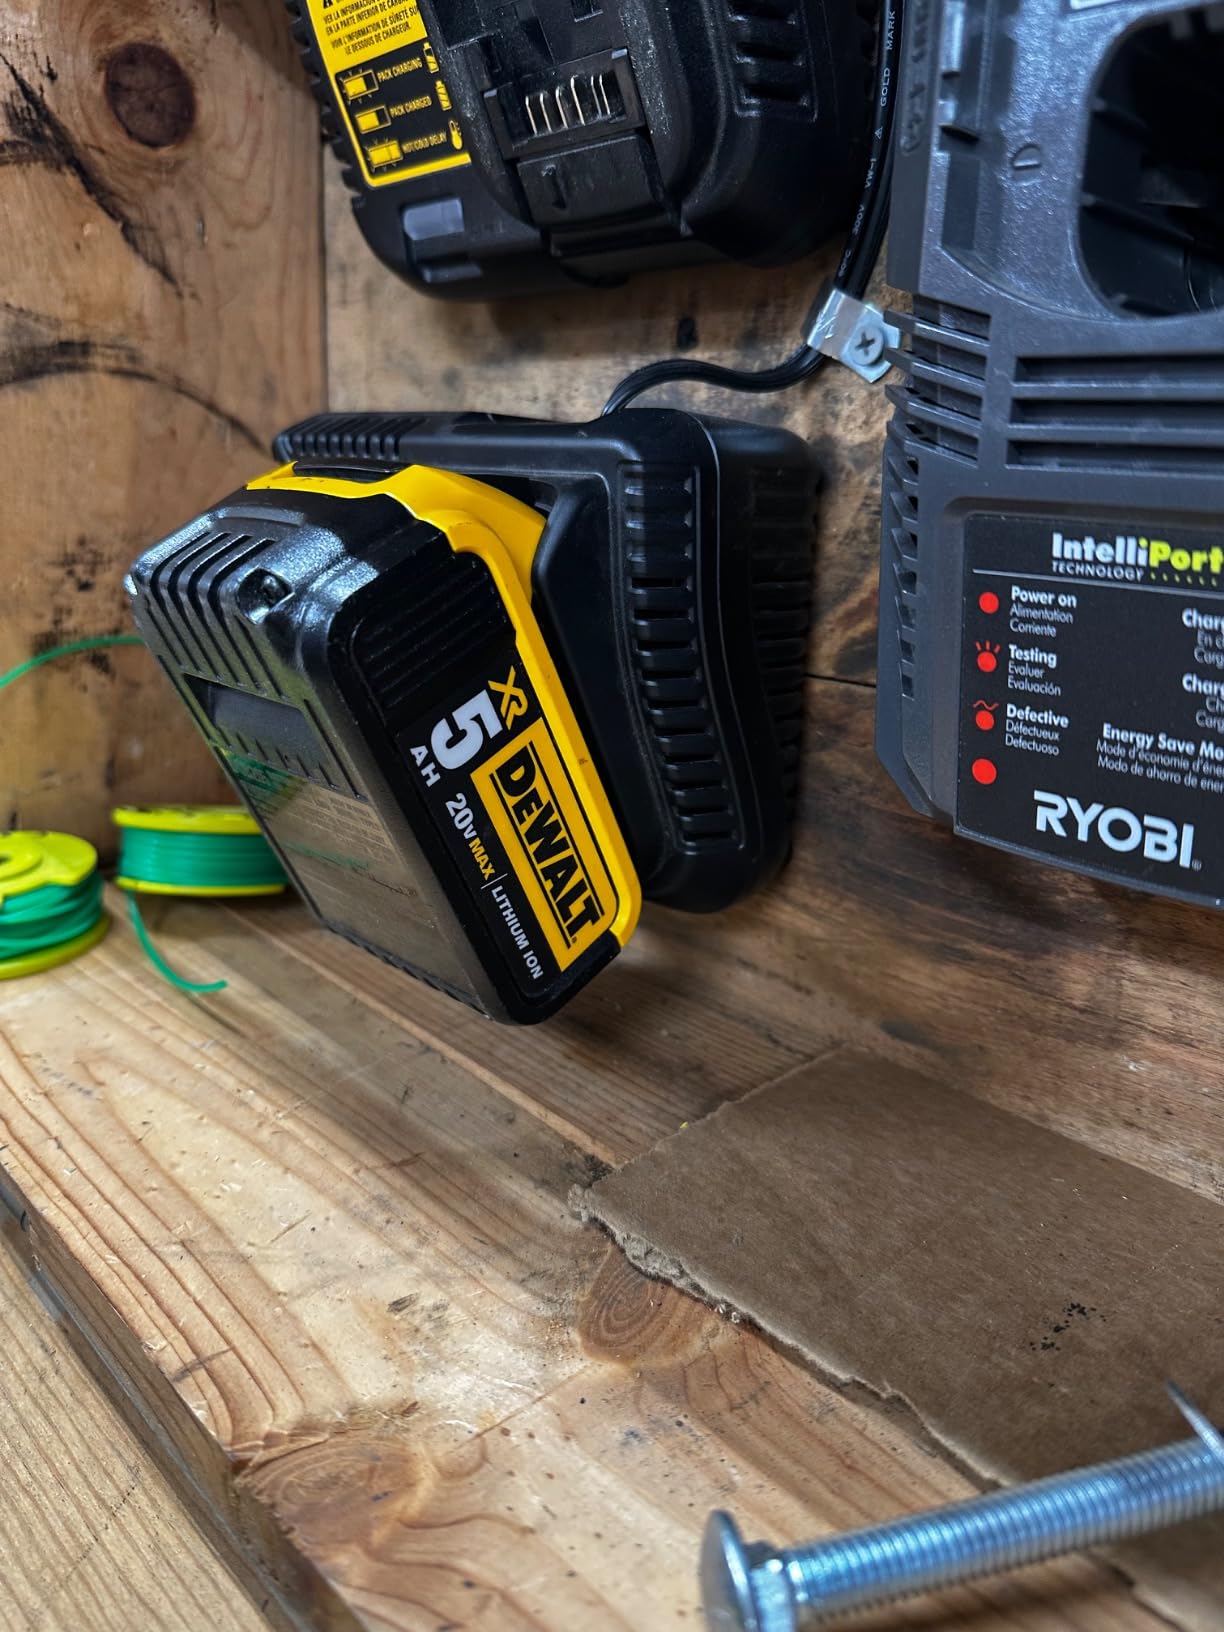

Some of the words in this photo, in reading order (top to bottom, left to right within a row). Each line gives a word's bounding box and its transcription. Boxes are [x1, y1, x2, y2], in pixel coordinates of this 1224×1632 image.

[340, 15, 356, 28] PARTE
[356, 4, 380, 22] INFERIOR
[377, 68, 393, 82] PACK
[392, 57, 423, 76] CHARGING
[880, 67, 891, 107] GOLD
[886, 10, 896, 50] MARK
[390, 105, 406, 118] PACK
[404, 96, 432, 112] CHARGED
[1052, 561, 1144, 582] TECHNOLOGY
[1011, 585, 1055, 604] Power
[1058, 593, 1077, 608] on
[1010, 603, 1073, 624] Alimentation
[1010, 618, 1057, 637] Corriente
[1008, 644, 1057, 668] Testing
[1008, 660, 1044, 679] Evaluer
[1008, 675, 1061, 696] Evaluación
[488, 665, 529, 731] XR
[1006, 703, 1069, 728] Defective
[431, 689, 503, 770] 5
[1006, 719, 1060, 742] Défectueux
[1103, 722, 1154, 750] Energy
[1158, 732, 1195, 756] Save
[1005, 735, 1059, 756] Defectuoso
[1097, 738, 1126, 758] Mode
[1098, 754, 1128, 773] Modo
[1130, 760, 1144, 777] de
[1146, 765, 1181, 785] ahorro
[1184, 770, 1198, 789] de
[495, 741, 601, 938] DEWALT
[1033, 789, 1195, 869] RYOBI
[491, 884, 530, 950] LITHIUM
[523, 945, 544, 980] ION
